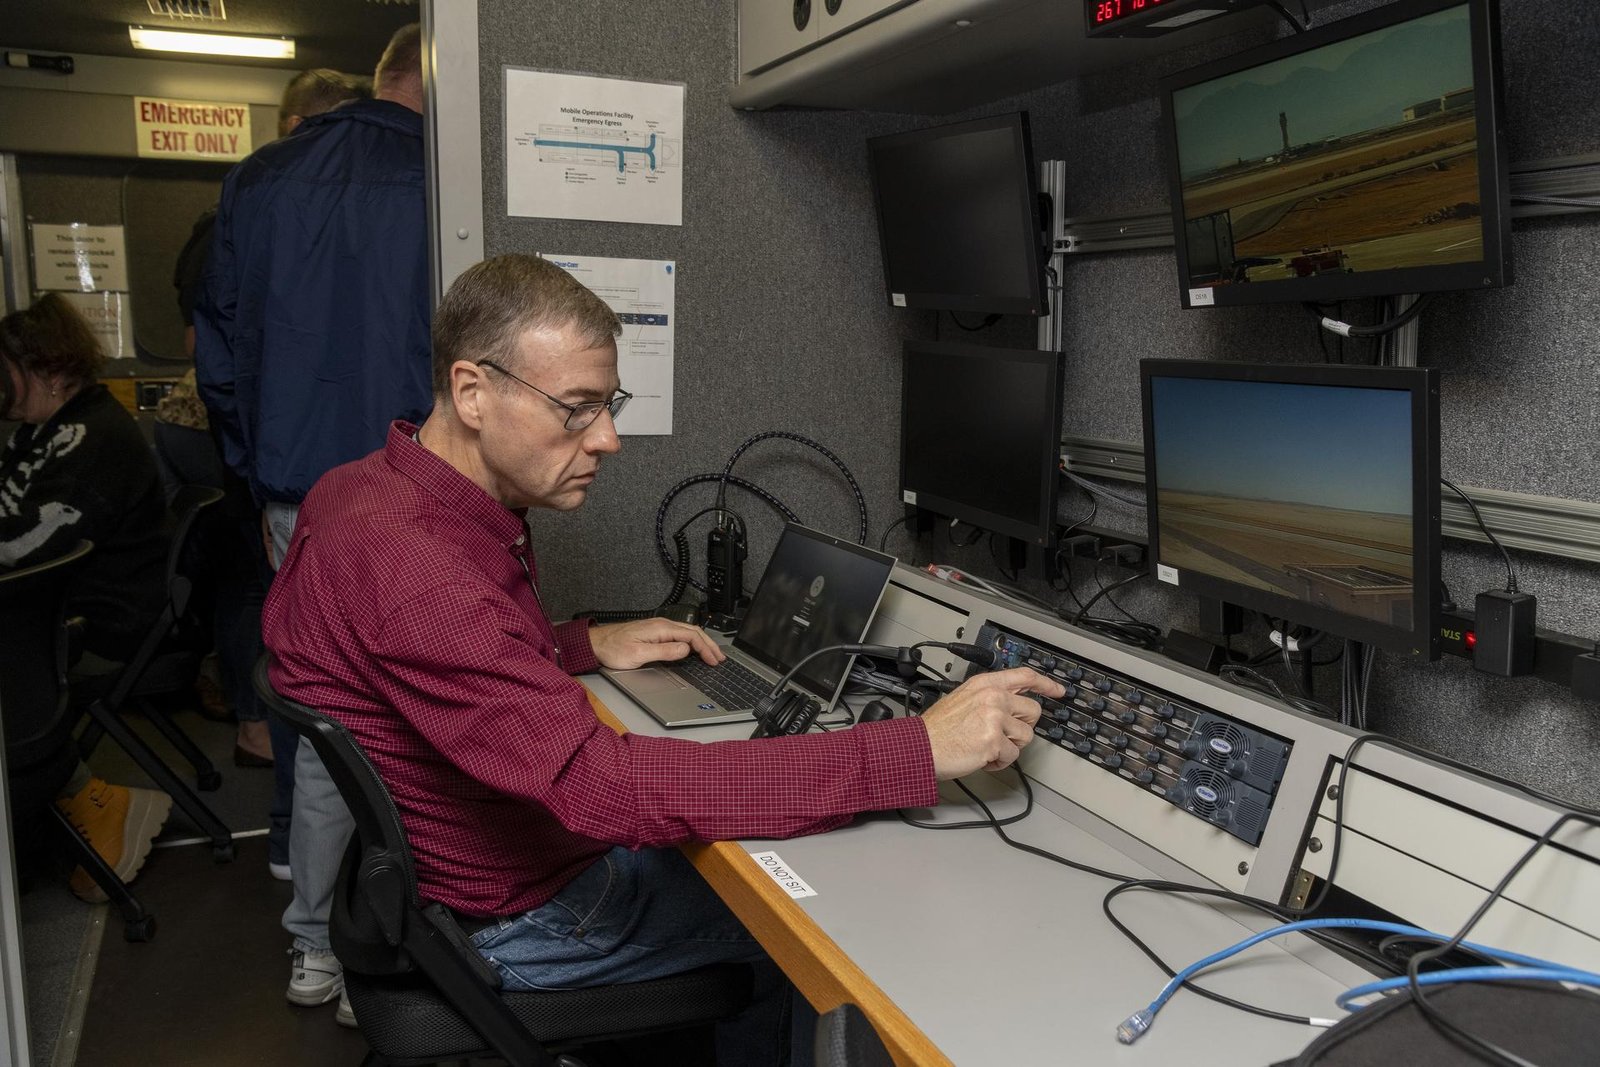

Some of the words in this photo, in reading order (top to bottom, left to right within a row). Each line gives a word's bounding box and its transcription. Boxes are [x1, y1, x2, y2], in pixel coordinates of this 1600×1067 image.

[1097, 0, 1121, 21] 267
[141, 102, 245, 128] EMERGENCY
[560, 107, 581, 115] Mobile
[582, 109, 613, 118] Operations
[614, 111, 634, 120] Facility
[572, 116, 604, 126] Emergency
[604, 118, 622, 127] Egress
[151, 130, 189, 151] EXIT
[194, 132, 239, 154] ONLY
[760, 856, 777, 866] DO
[770, 866, 794, 881] NOT
[785, 881, 807, 893] SIT
